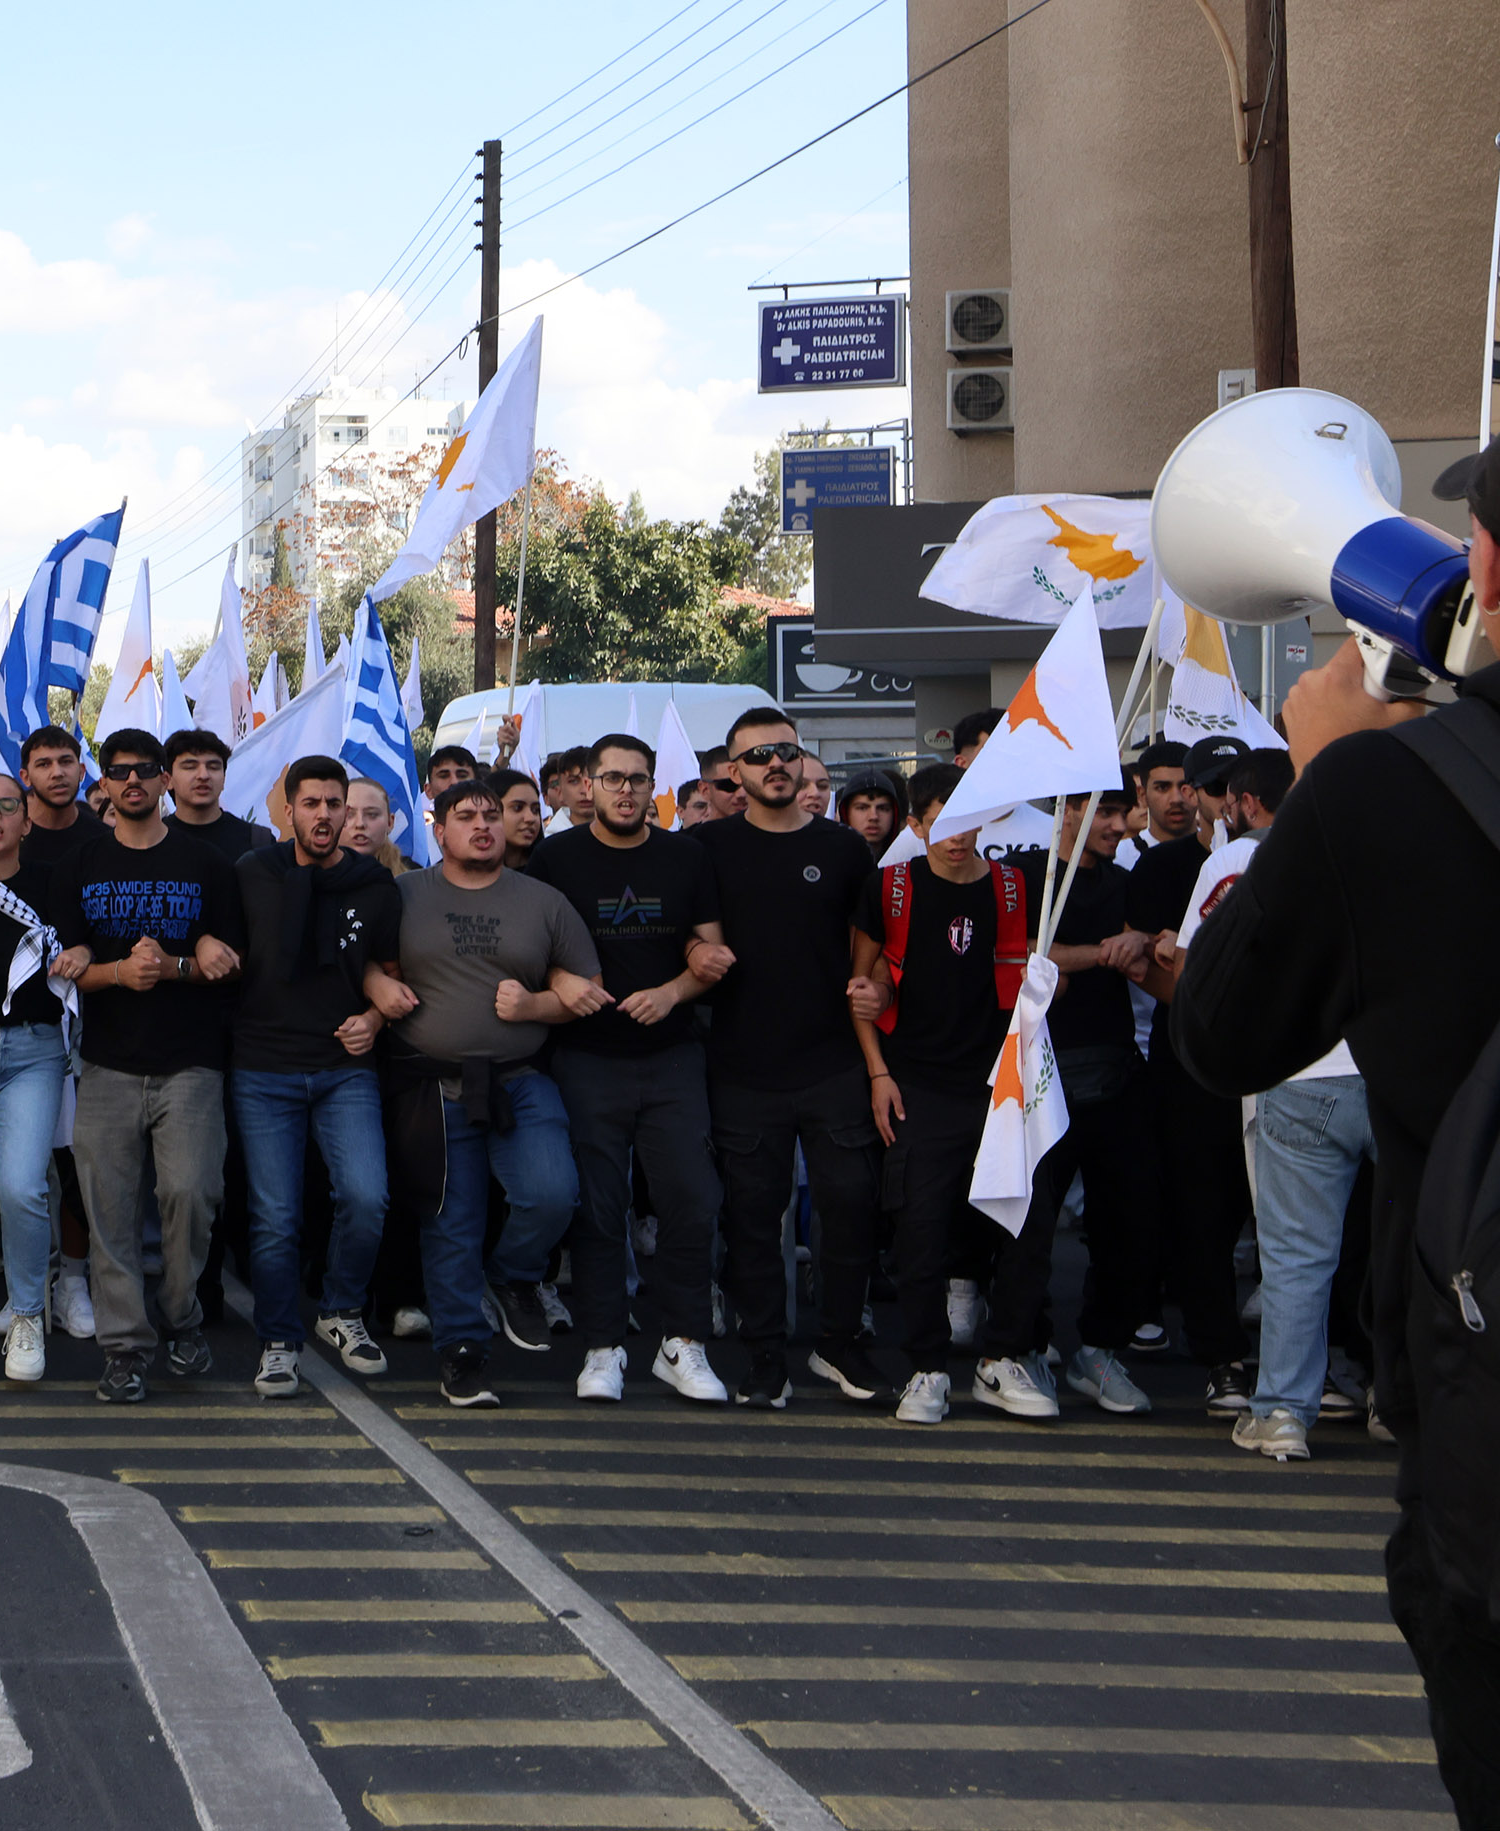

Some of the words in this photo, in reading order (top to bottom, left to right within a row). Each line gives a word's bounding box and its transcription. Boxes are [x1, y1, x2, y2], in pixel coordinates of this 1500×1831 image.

[787, 319, 811, 331] ALKIS
[812, 333, 877, 347] ΠΑΙΔΙΑΤΡΟΣ
[804, 348, 885, 364] PAEDIATRICIAN
[811, 371, 823, 381] 22
[825, 370, 836, 380] 31
[839, 369, 851, 379] 77
[824, 481, 880, 491] ΠΑΙΔΙΑΤΡΟΣ
[817, 494, 888, 504] PAEDIATRICIAN
[155, 880, 202, 897] SOUND
[110, 895, 134, 918] LOOP
[166, 895, 202, 921] TOUR
